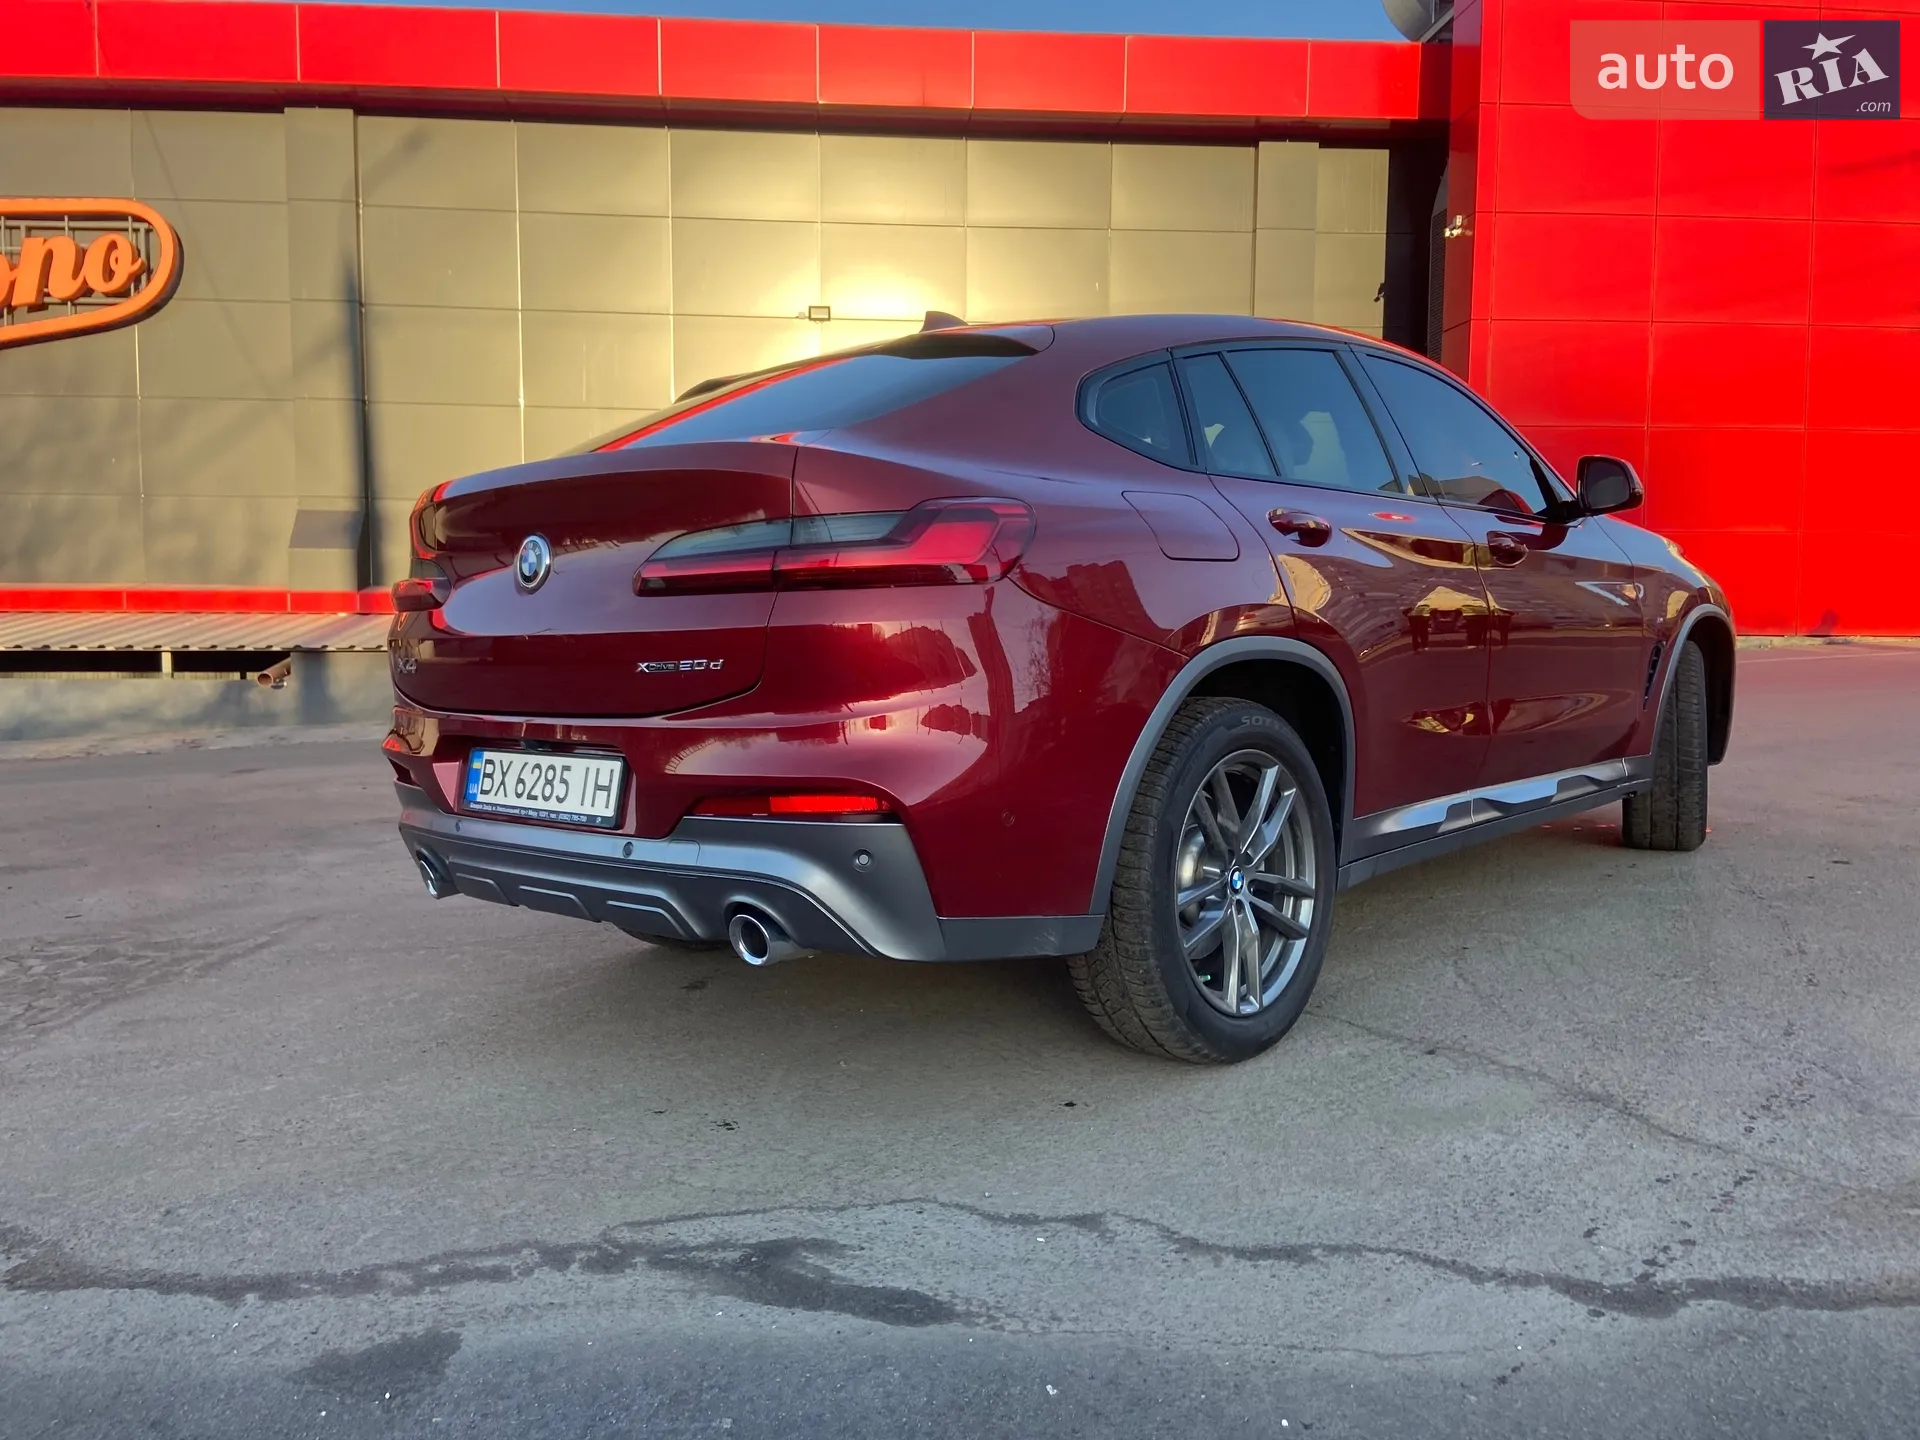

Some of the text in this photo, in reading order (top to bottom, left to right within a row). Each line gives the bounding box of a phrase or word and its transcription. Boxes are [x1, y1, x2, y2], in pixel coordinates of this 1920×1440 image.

[397, 657, 418, 674] X4
[468, 783, 479, 795] UA
[479, 758, 615, 809] BX 6285 IH
